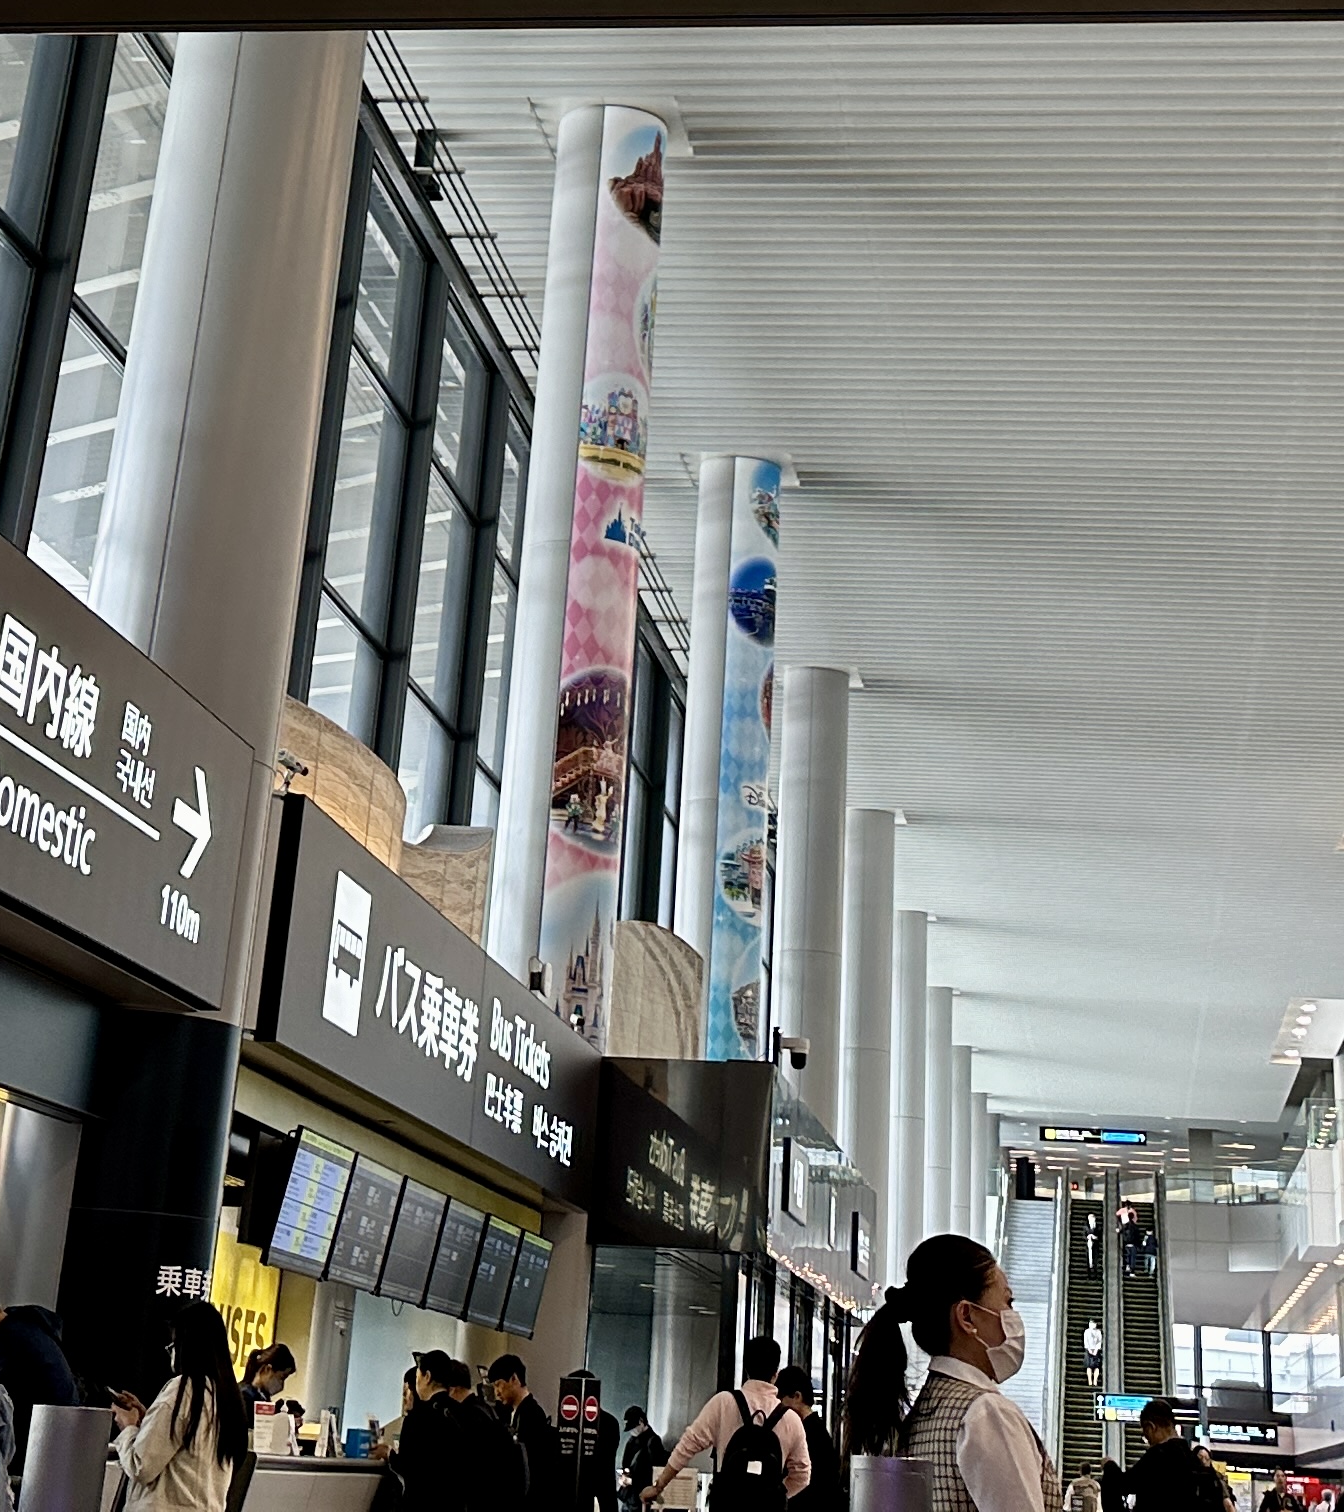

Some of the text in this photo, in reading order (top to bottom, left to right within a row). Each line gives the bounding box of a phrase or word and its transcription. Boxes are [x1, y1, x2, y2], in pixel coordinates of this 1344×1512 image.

[121, 701, 152, 756] 国内
[115, 748, 156, 809] 국내선
[160, 884, 201, 944] 110m
[375, 945, 480, 1082] バス乗車券
[490, 997, 551, 1090] Bus Tickets
